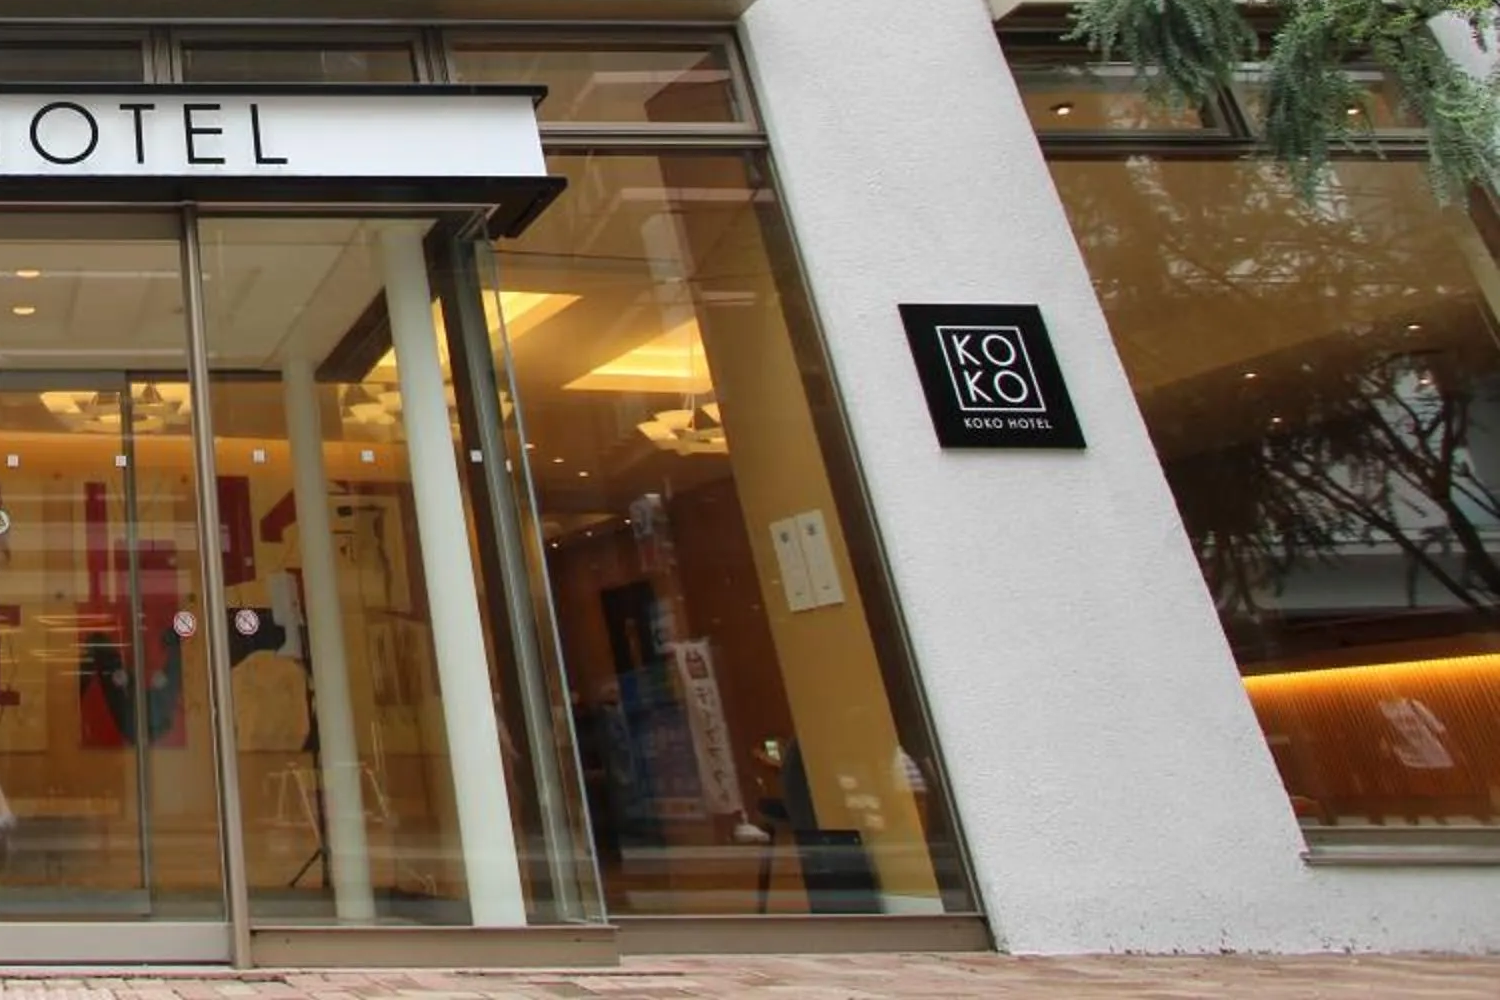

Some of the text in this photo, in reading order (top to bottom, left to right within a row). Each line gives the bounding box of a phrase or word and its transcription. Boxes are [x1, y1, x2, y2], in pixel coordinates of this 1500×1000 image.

[952, 333, 1017, 367] KO
[963, 370, 1029, 403] KO
[963, 417, 1054, 430] KOKO HOTEL
